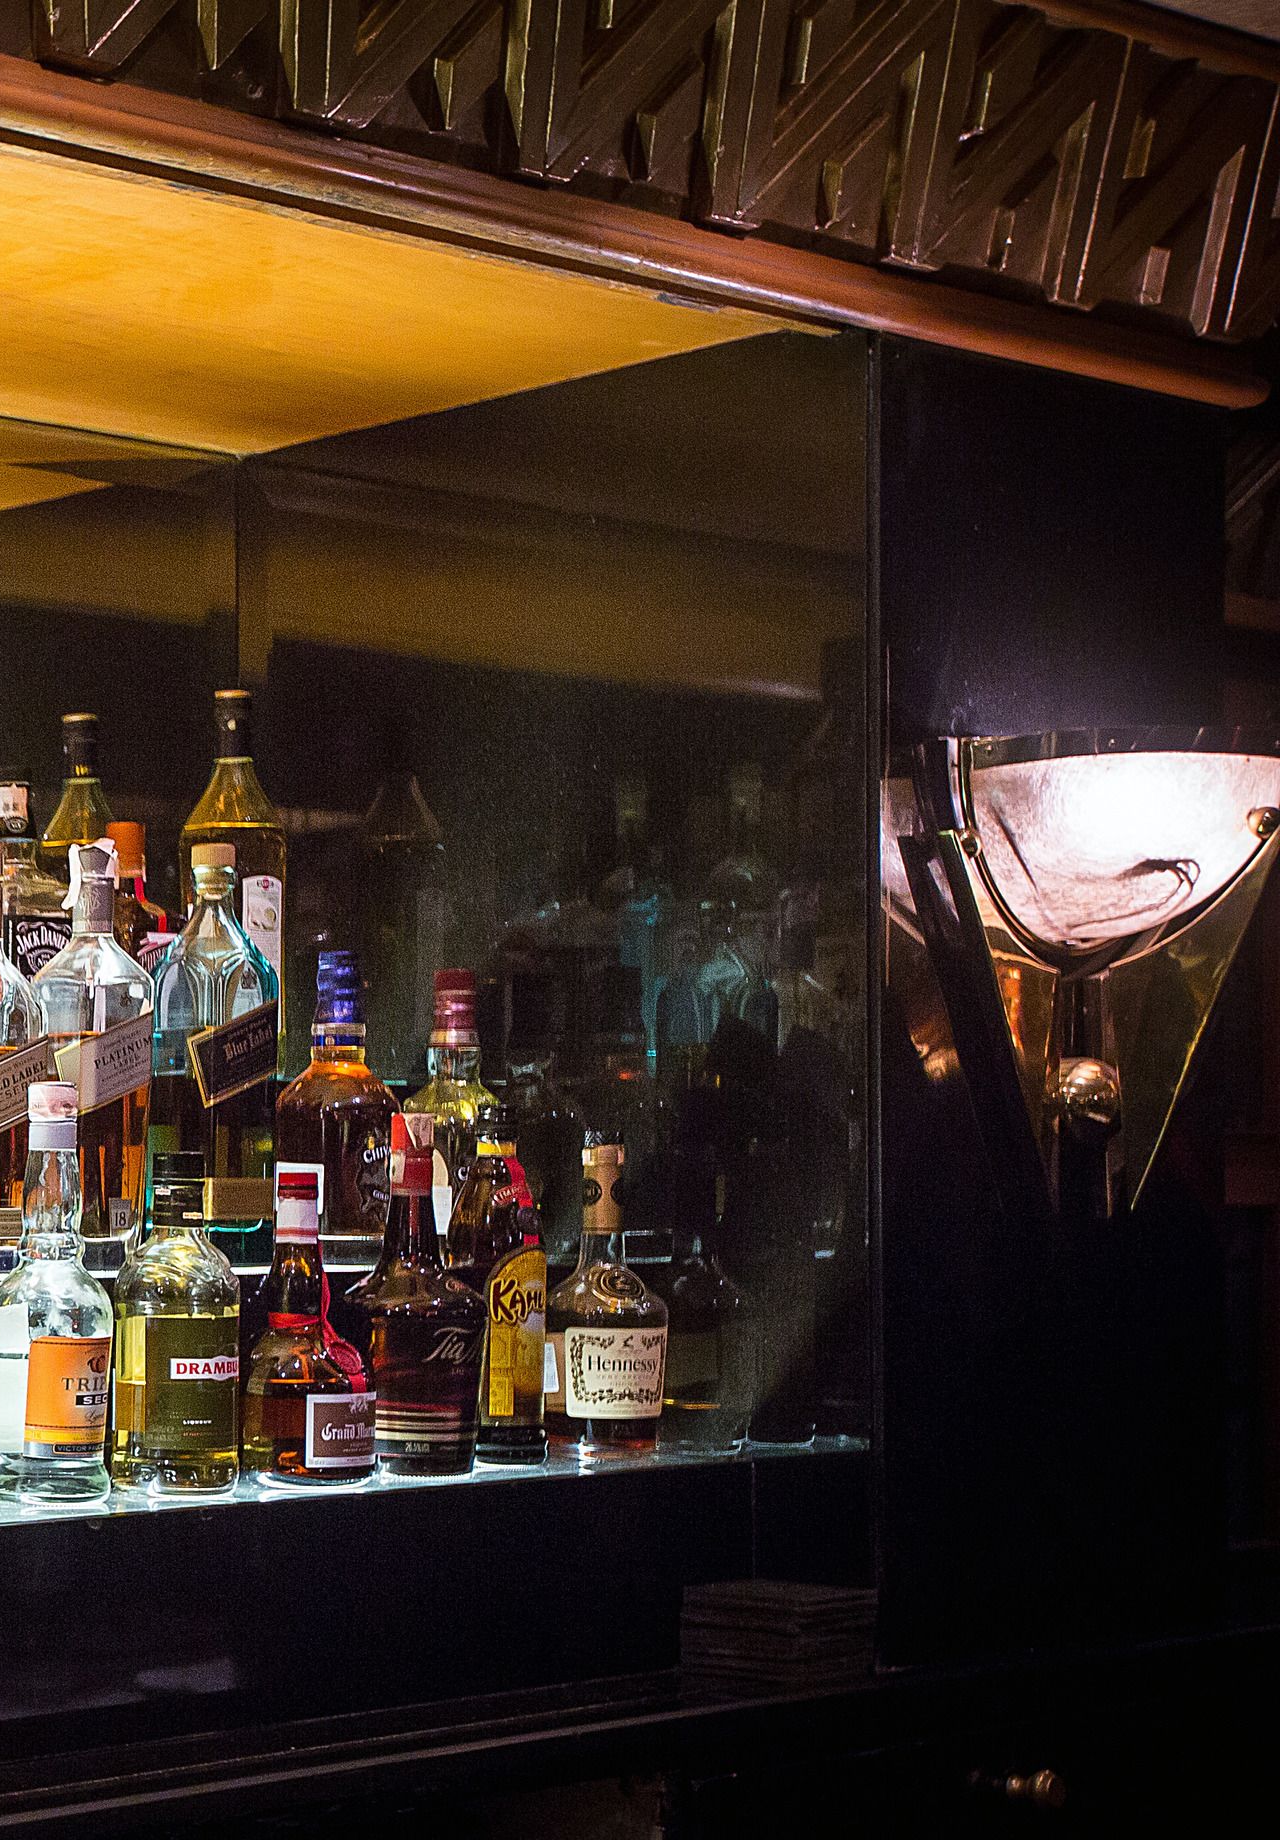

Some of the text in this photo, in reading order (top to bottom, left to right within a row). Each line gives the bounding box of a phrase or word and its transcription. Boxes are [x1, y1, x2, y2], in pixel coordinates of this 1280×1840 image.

[15, 927, 40, 956] JACK
[94, 1035, 152, 1069] PLATINUM
[114, 1211, 127, 1227] 18
[586, 1354, 657, 1374] Hennessy
